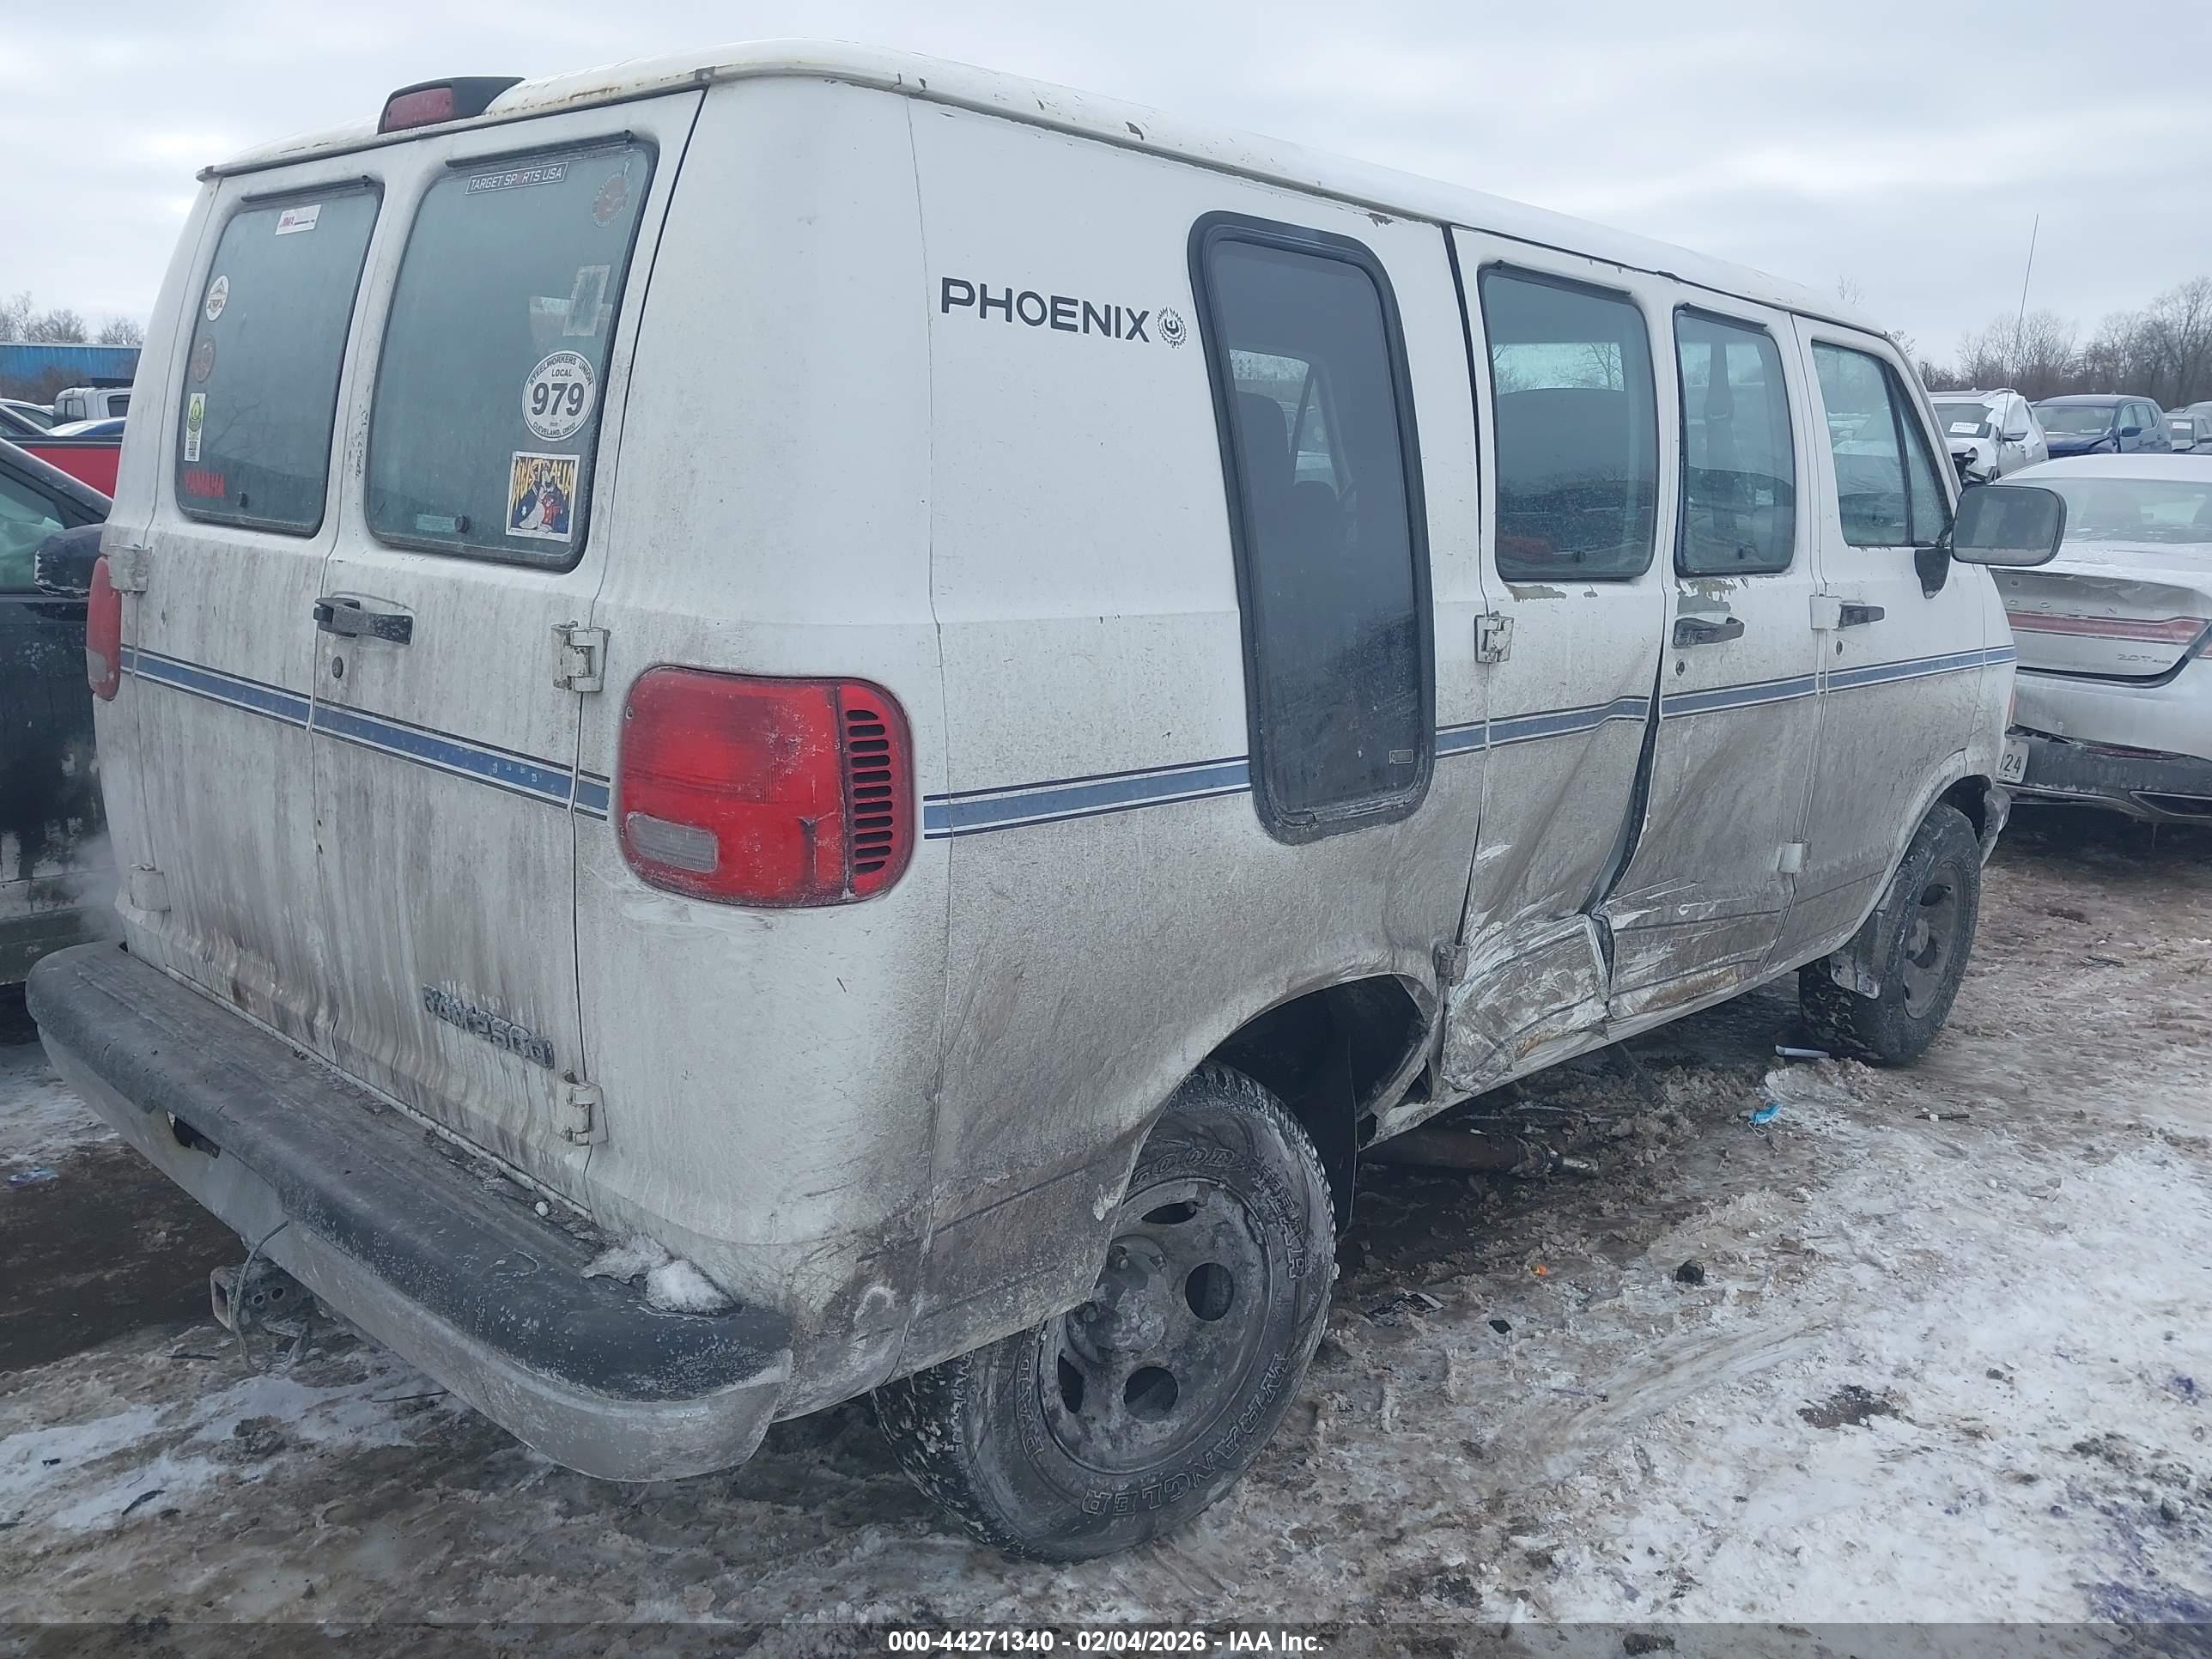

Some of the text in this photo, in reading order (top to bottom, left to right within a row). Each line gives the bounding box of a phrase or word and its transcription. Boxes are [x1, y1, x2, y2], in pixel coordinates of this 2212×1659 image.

[471, 167, 562, 190] TARGET SPRTS USA
[941, 276, 1150, 343] PHOENIX
[529, 356, 593, 386] STEELWORKERS UNION
[551, 368, 573, 378] LOCAL
[531, 382, 585, 416] 979
[562, 422, 576, 434] OHIO
[1082, 1353, 1288, 1516] WRANGLER
